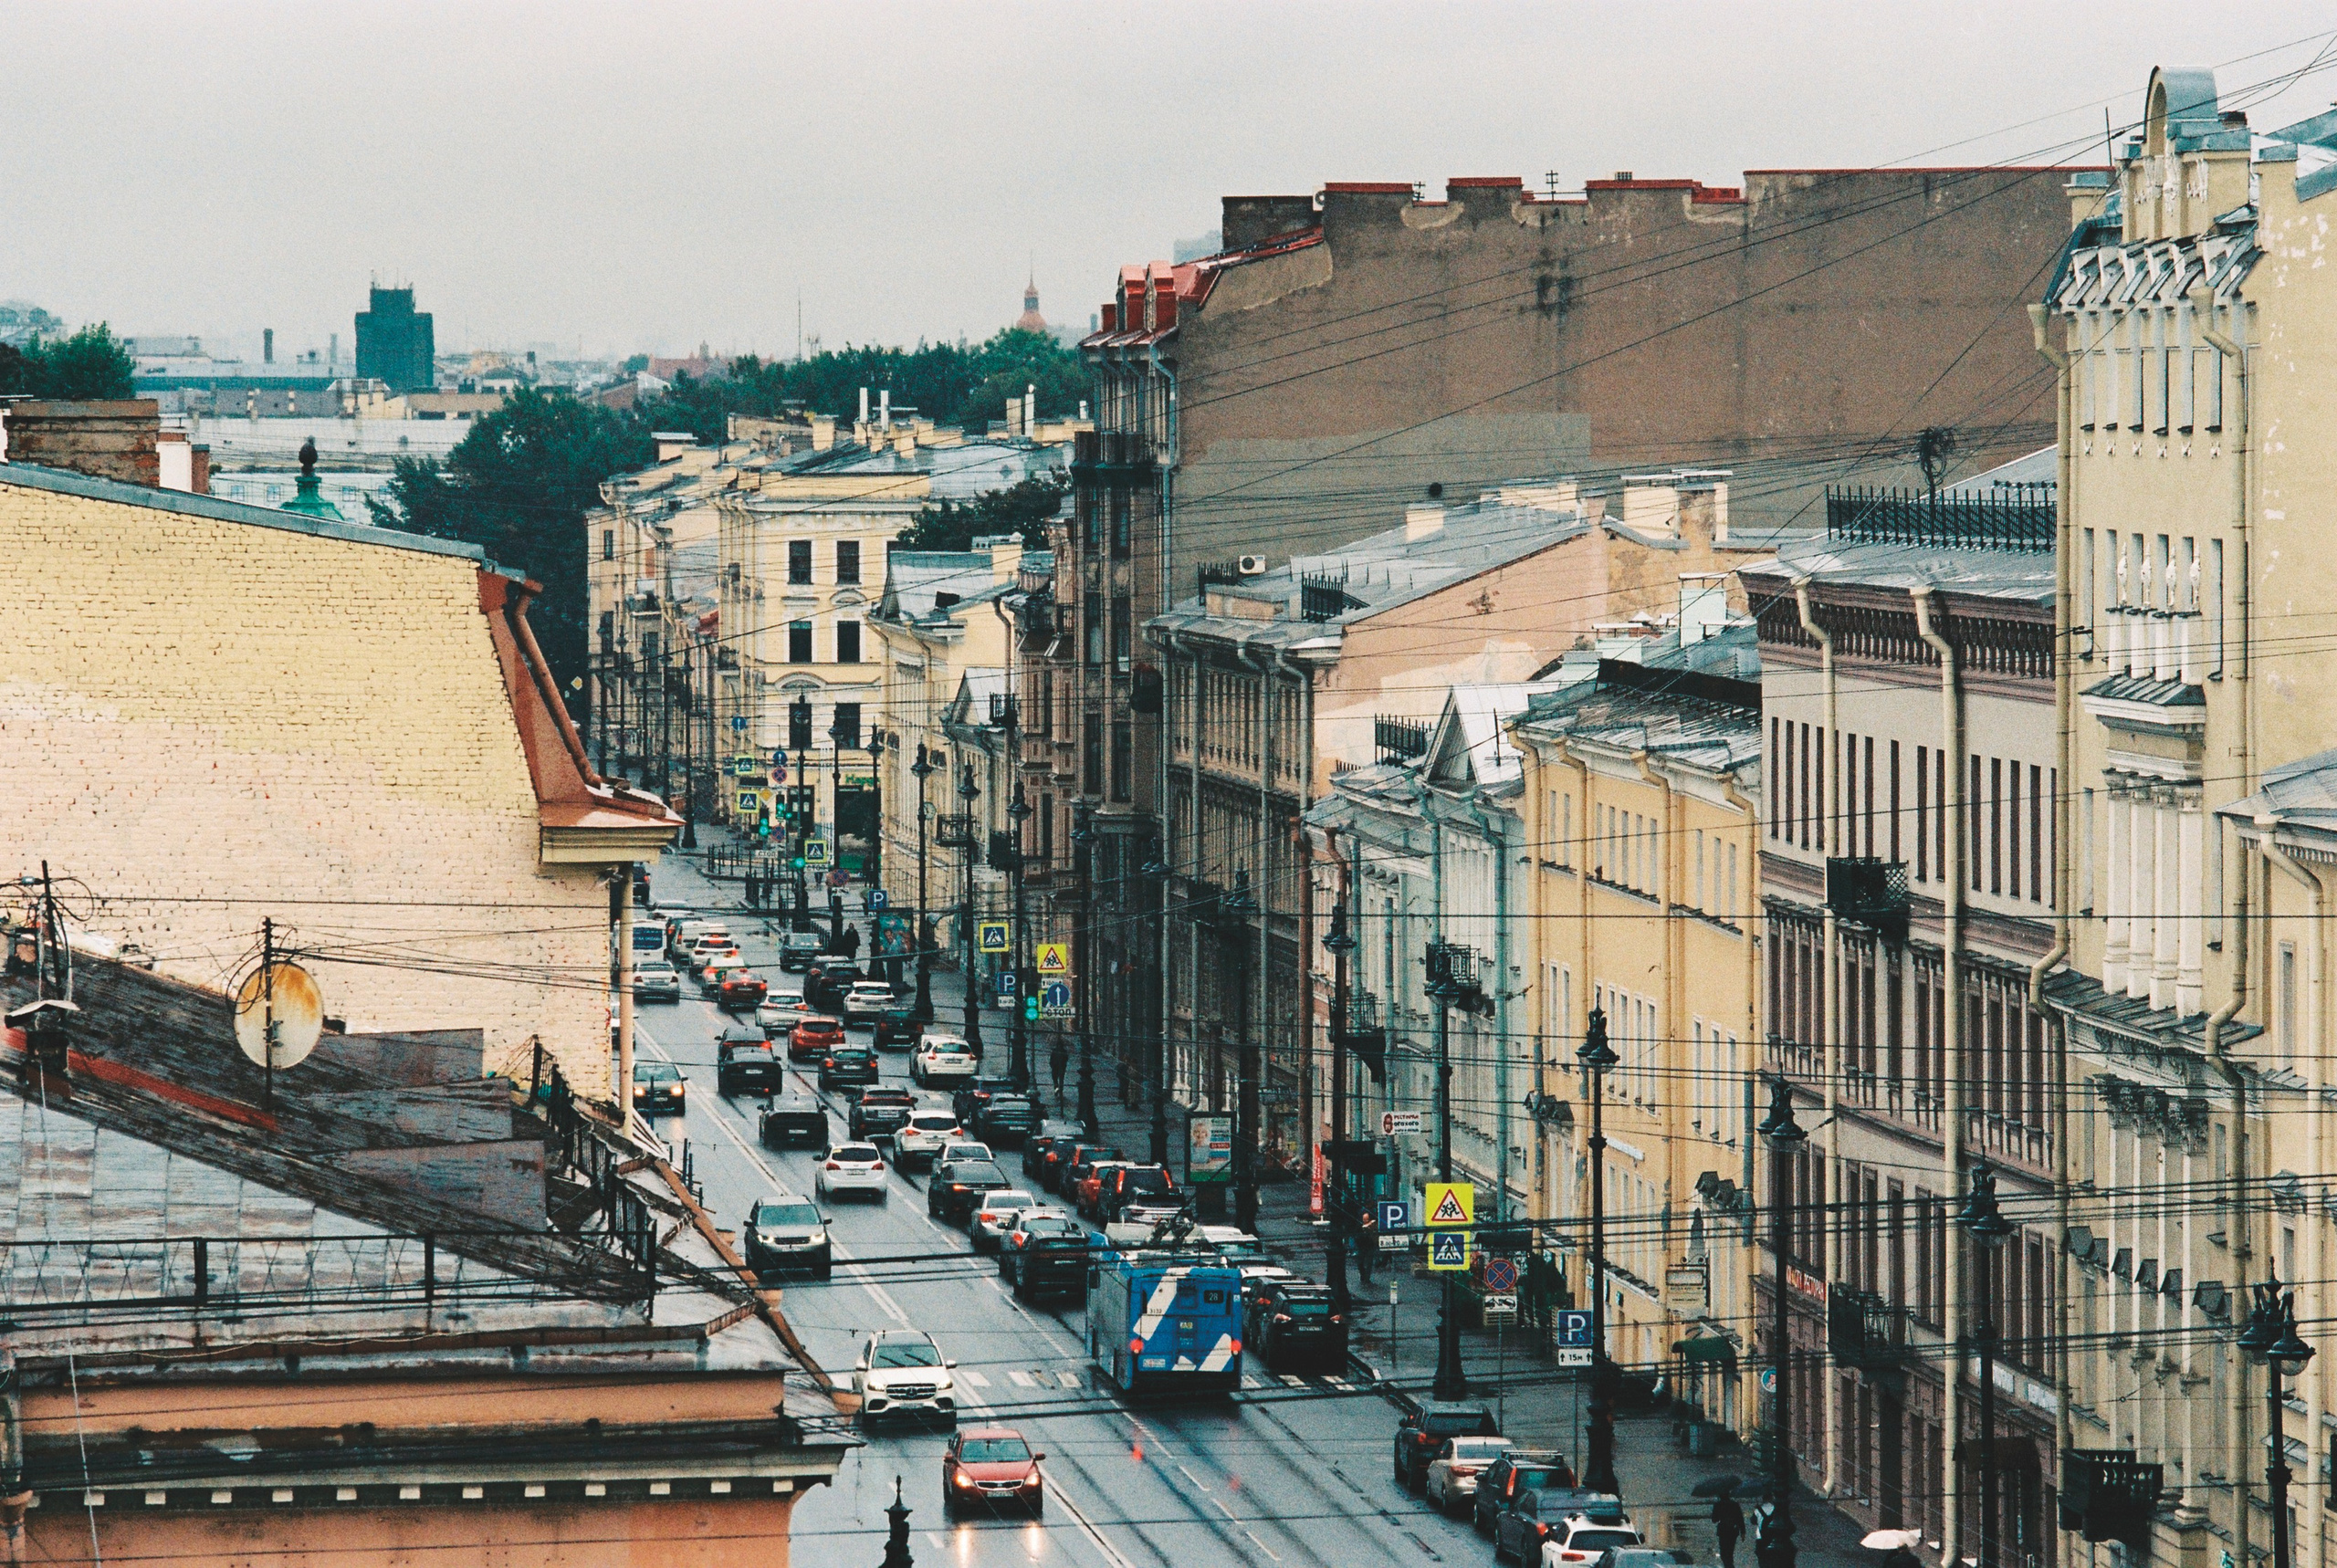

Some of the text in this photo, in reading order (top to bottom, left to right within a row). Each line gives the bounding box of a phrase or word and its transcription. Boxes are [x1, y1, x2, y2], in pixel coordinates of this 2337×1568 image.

[874, 892, 884, 907] P
[1004, 975, 1016, 992] P
[1046, 1008, 1072, 1017] СТОП
[1387, 1205, 1403, 1228] P
[1209, 1292, 1219, 1301] 28
[1567, 1314, 1587, 1342] P
